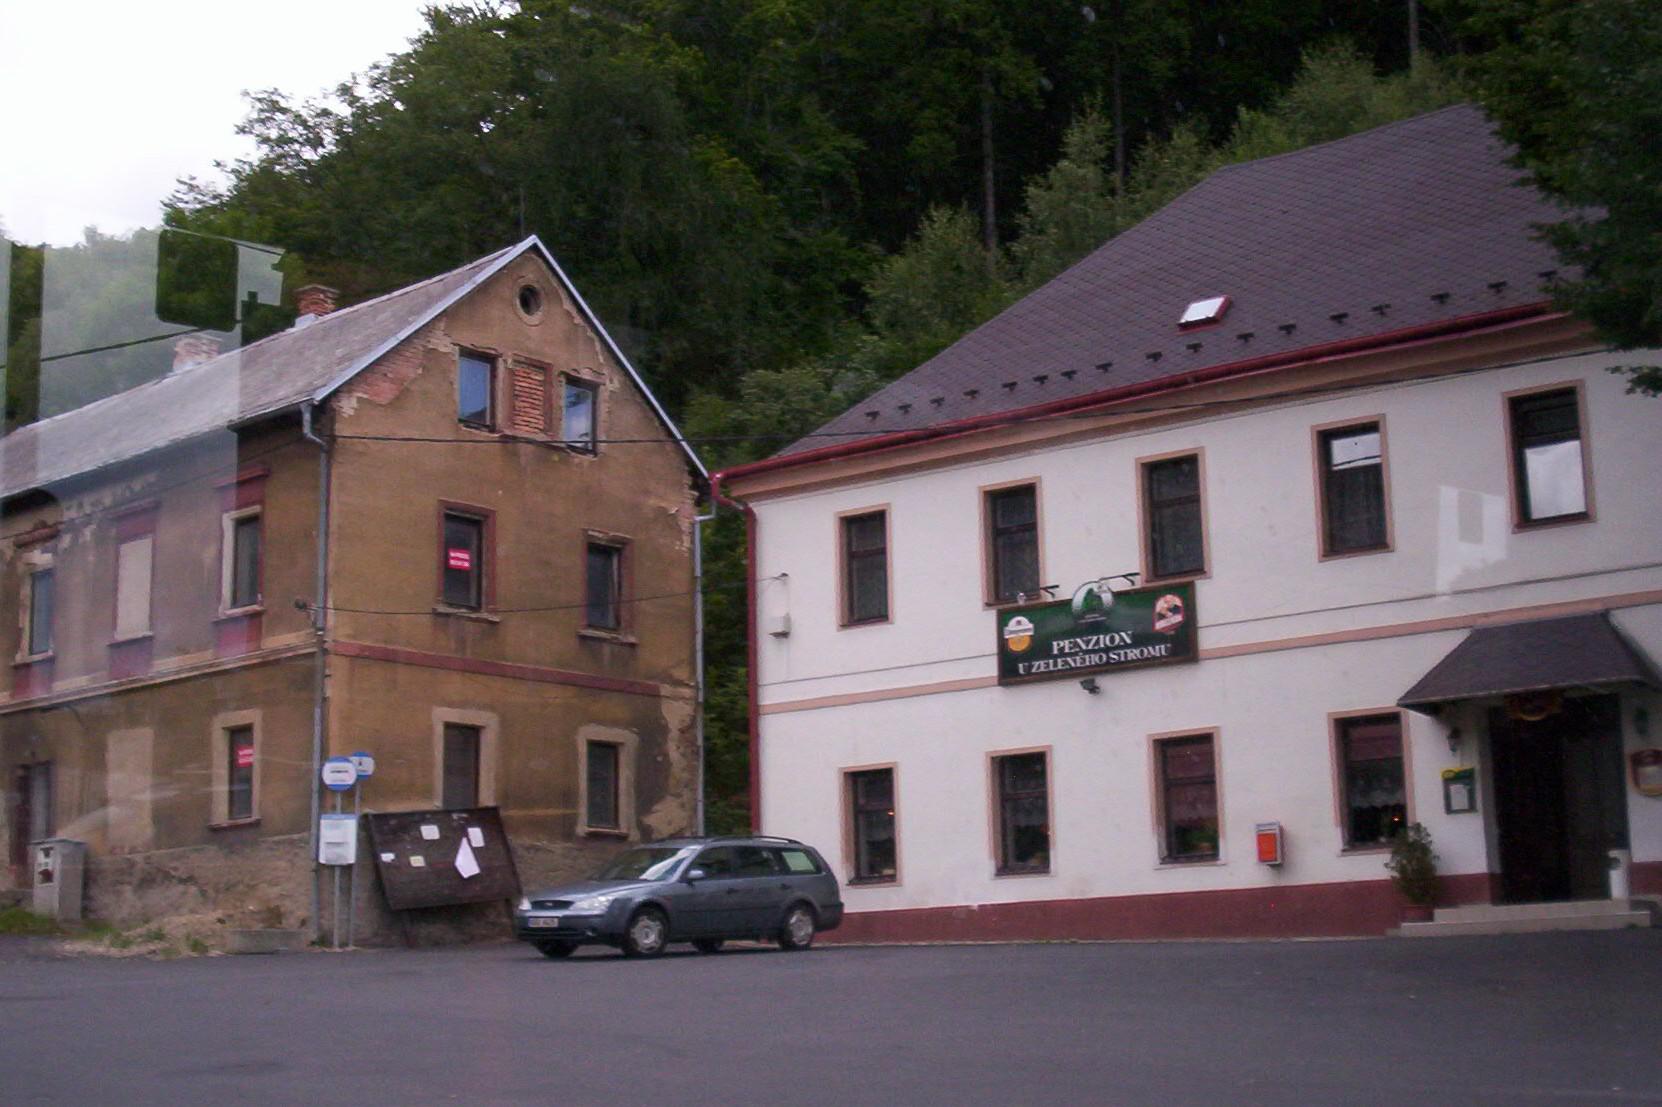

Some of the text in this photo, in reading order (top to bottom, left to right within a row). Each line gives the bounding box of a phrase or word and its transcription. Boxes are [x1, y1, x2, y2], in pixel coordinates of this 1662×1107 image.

[1052, 631, 1133, 655] PENZION
[1018, 643, 1171, 675] U ZELENÉHO STROMU
